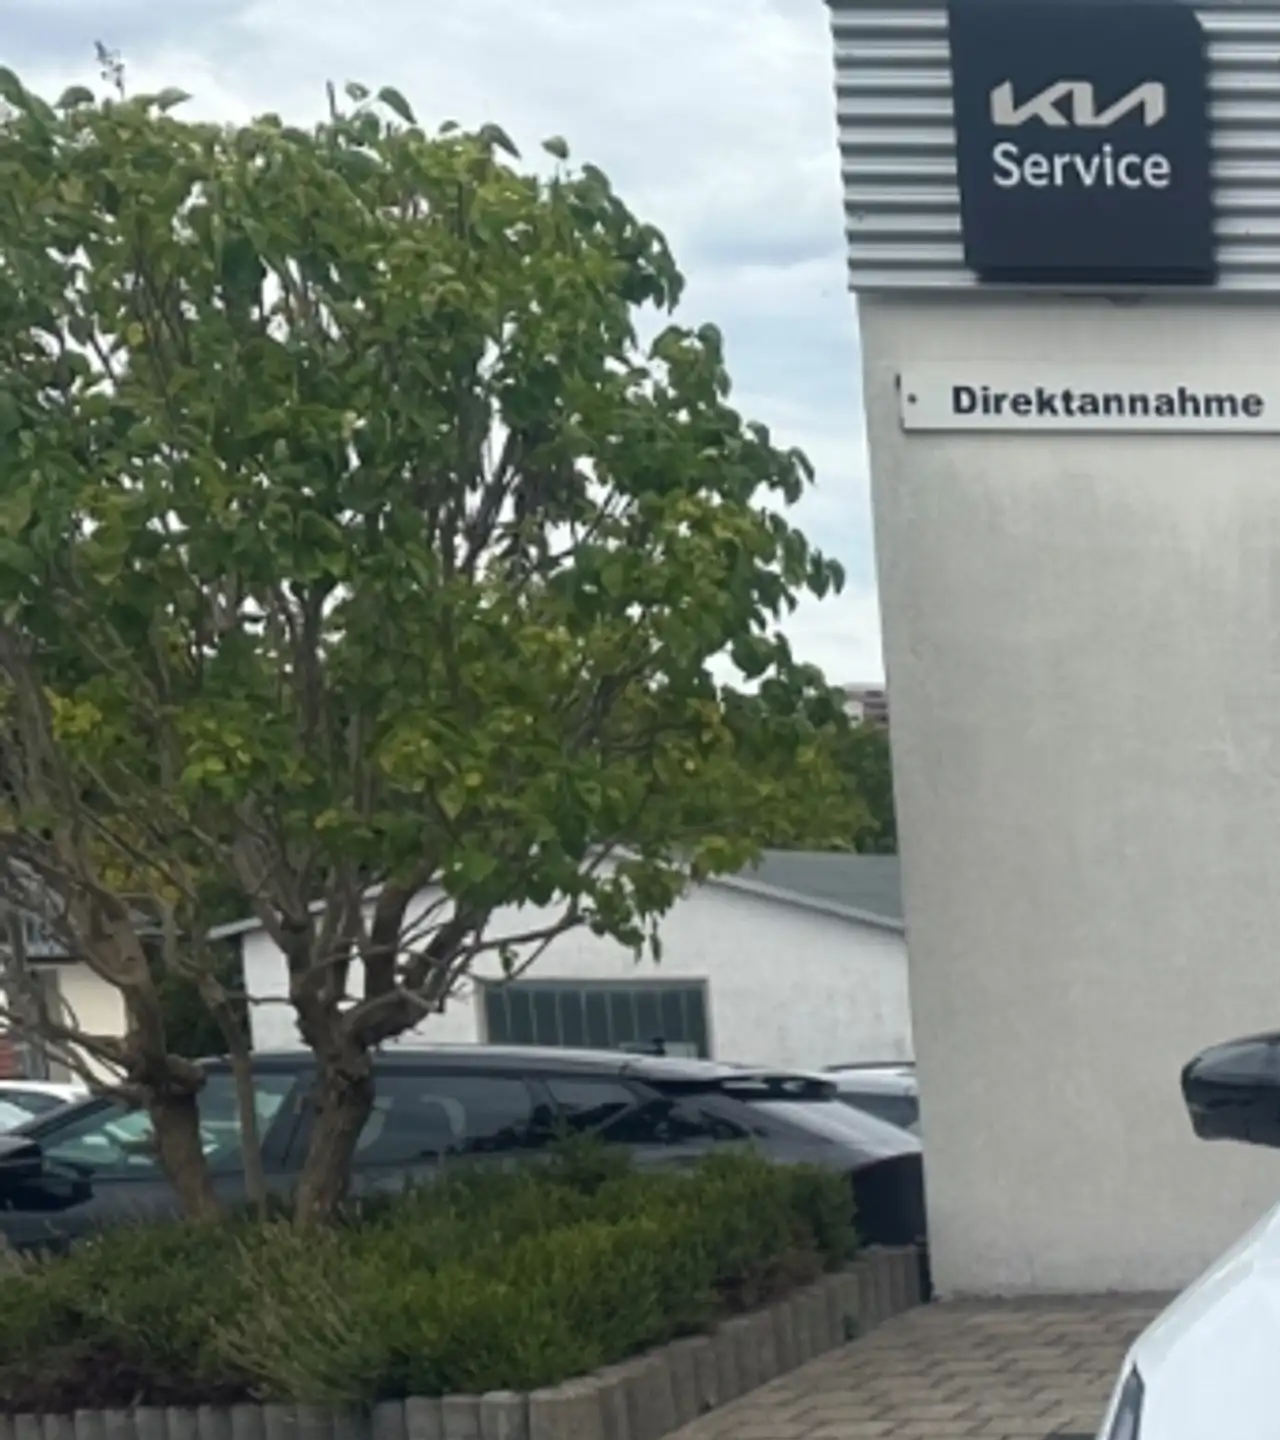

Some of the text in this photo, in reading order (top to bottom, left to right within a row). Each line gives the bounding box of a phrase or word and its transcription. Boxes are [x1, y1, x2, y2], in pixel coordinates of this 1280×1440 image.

[989, 79, 1167, 127] KIA
[991, 142, 1172, 188] Service
[951, 385, 1265, 417] Direktannahme
